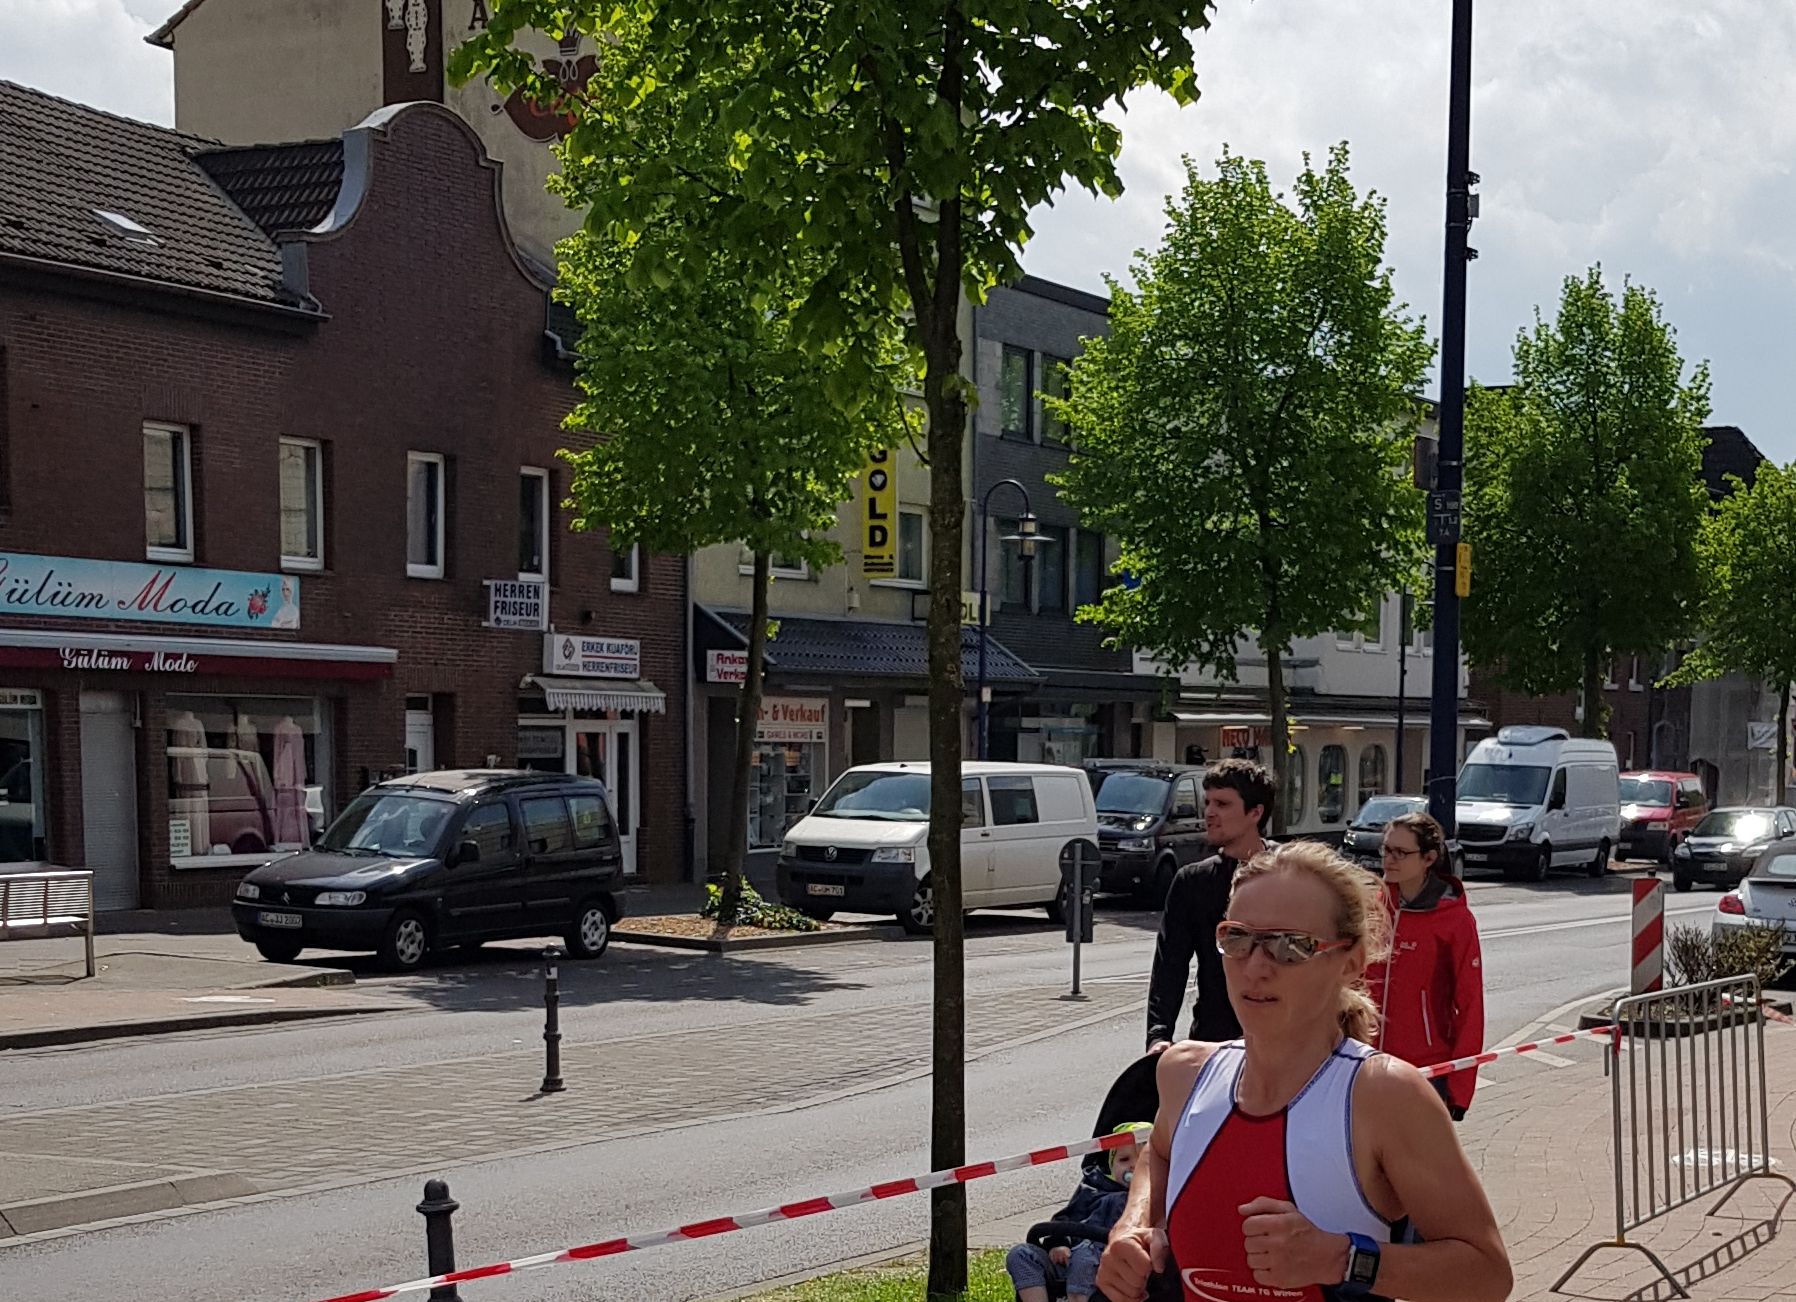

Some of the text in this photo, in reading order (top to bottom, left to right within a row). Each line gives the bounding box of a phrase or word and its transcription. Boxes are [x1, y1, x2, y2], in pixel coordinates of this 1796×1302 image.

[868, 449, 888, 547] GOLD
[117, 569, 241, 618] Moda
[494, 582, 541, 600] HERREN
[494, 600, 540, 618] FRISEUR
[59, 647, 132, 671] Gülüm
[781, 703, 826, 722] Verkauf
[1193, 1277, 1229, 1291] Triathlon
[1231, 1284, 1257, 1294] TEAM
